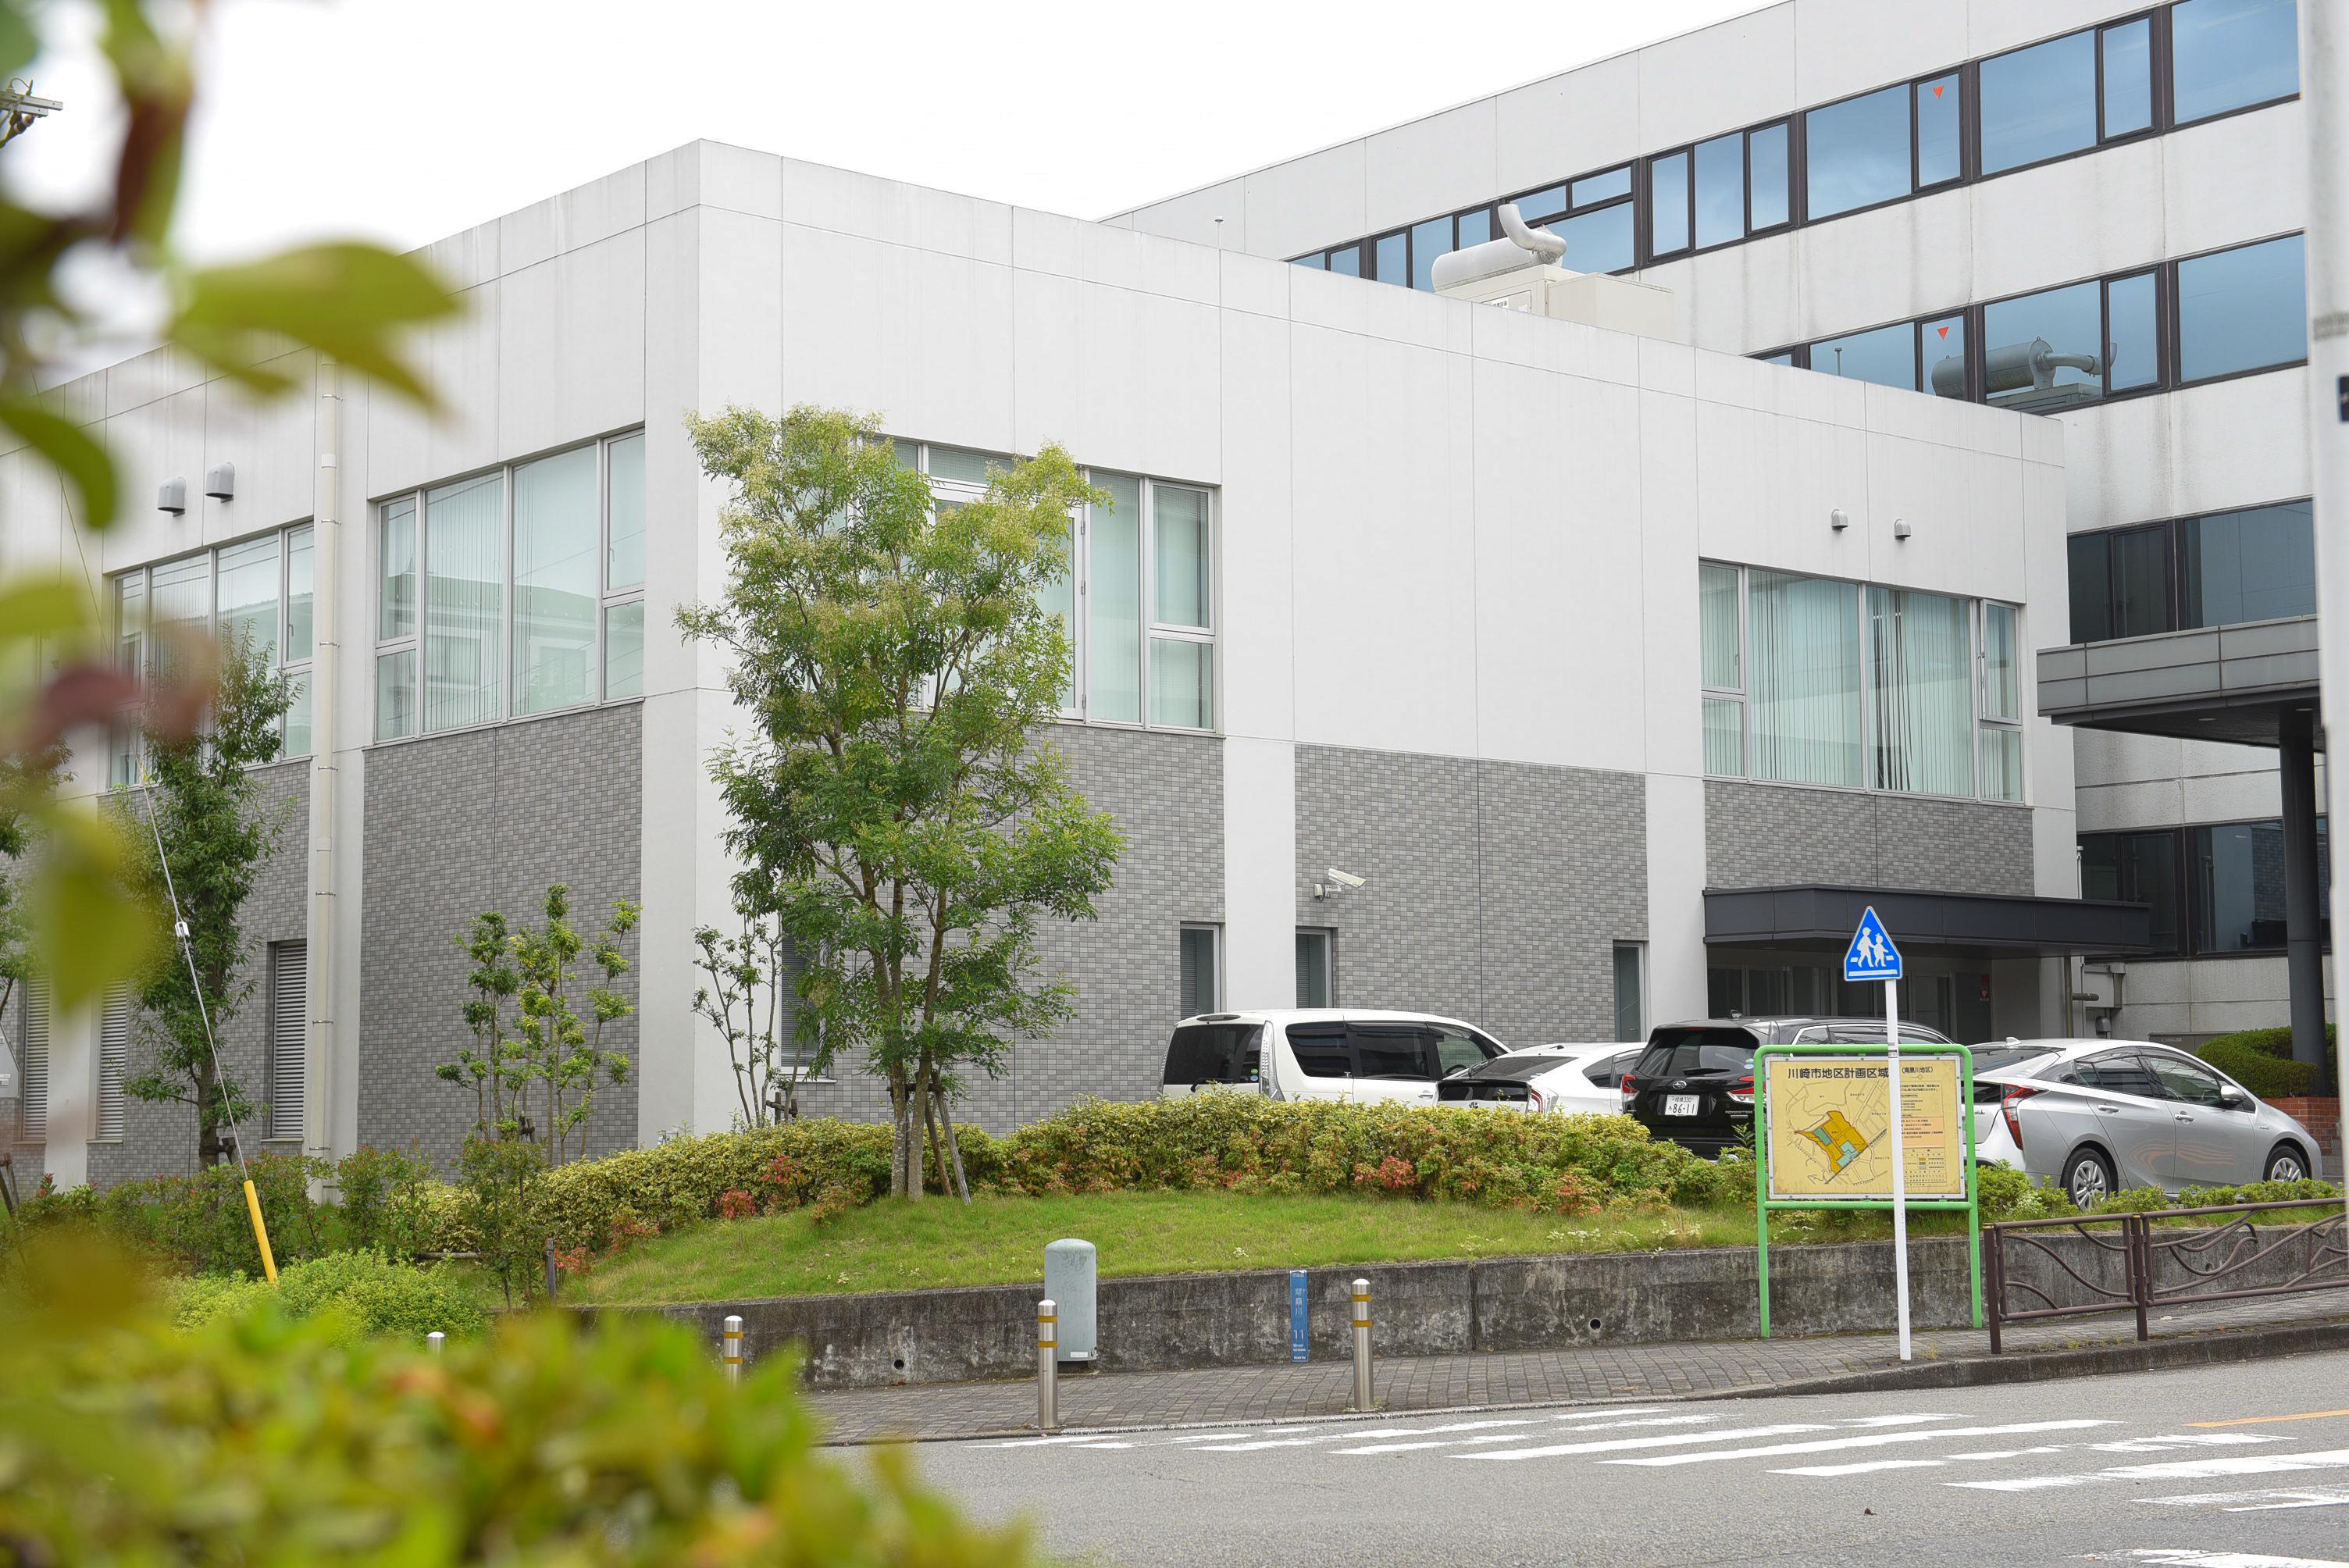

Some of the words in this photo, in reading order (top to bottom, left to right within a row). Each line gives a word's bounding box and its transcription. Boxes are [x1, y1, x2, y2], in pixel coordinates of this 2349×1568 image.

[1788, 1067, 1889, 1079] 川崎市地区計画区域
[1293, 1329, 1304, 1340] 11
